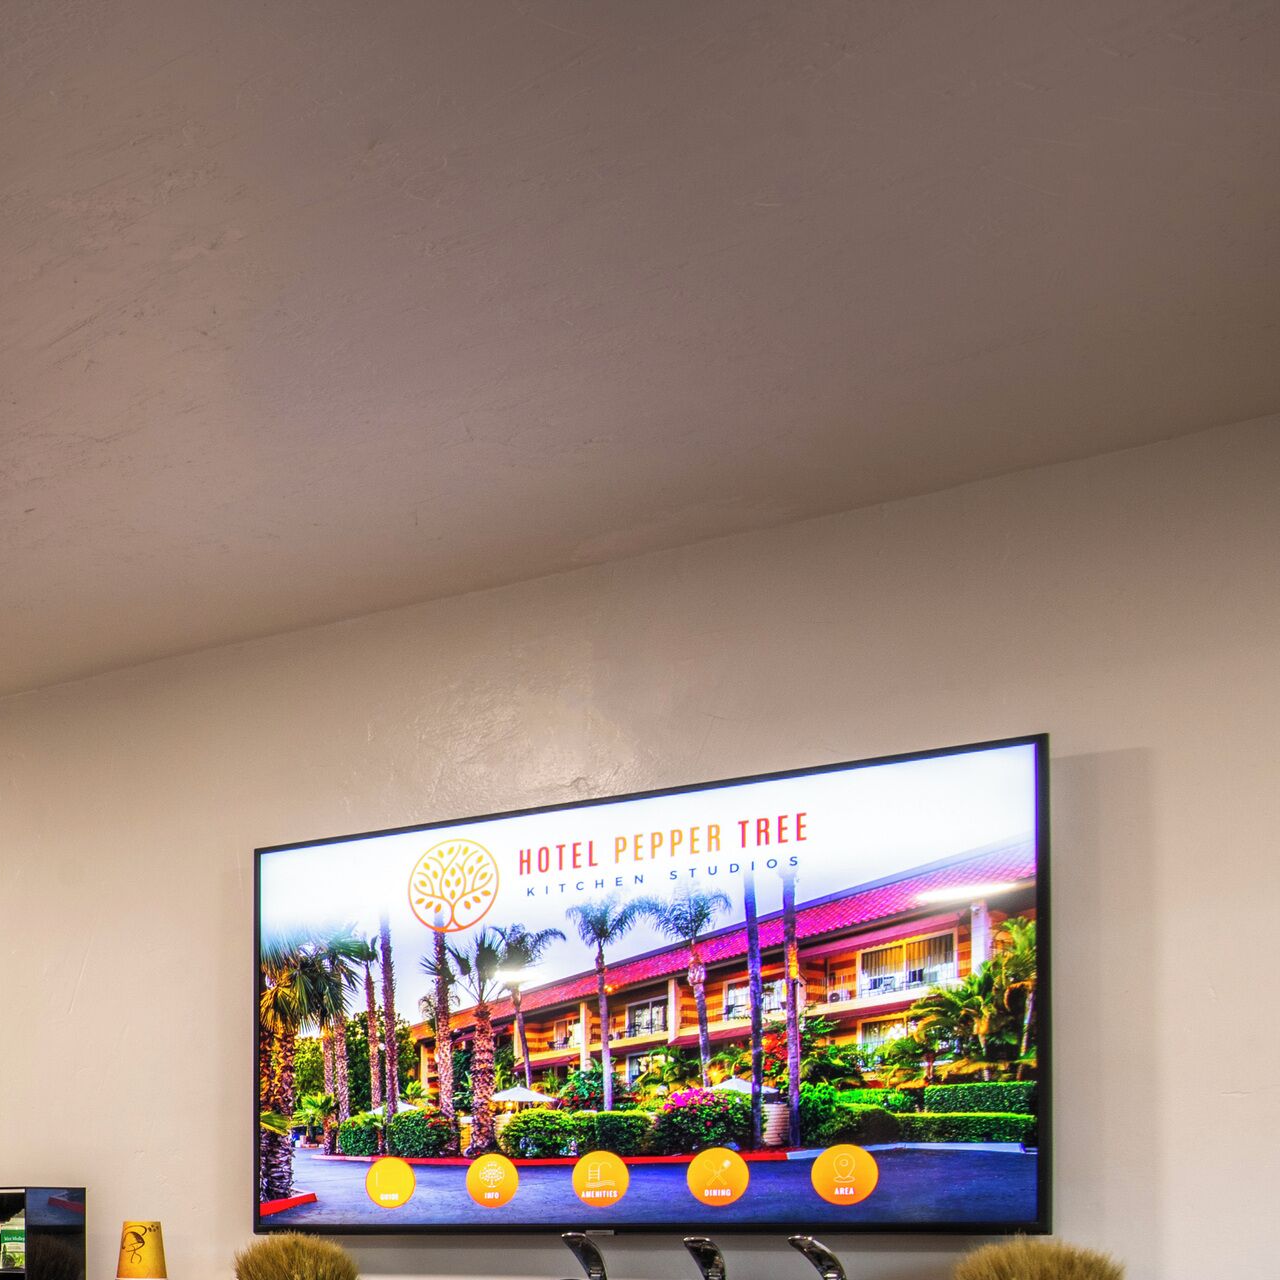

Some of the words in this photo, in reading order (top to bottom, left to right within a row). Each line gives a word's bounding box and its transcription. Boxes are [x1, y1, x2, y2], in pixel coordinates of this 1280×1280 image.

[519, 840, 599, 876] HOTEL
[614, 823, 721, 864] PEPPER
[737, 812, 808, 849] TREE
[526, 874, 645, 897] KITCHEN
[669, 855, 799, 881] STUDIOS
[483, 1191, 500, 1200] INFO
[580, 1189, 618, 1199] AMENITIES
[703, 1188, 732, 1197] DINING
[833, 1186, 855, 1196] AREA
